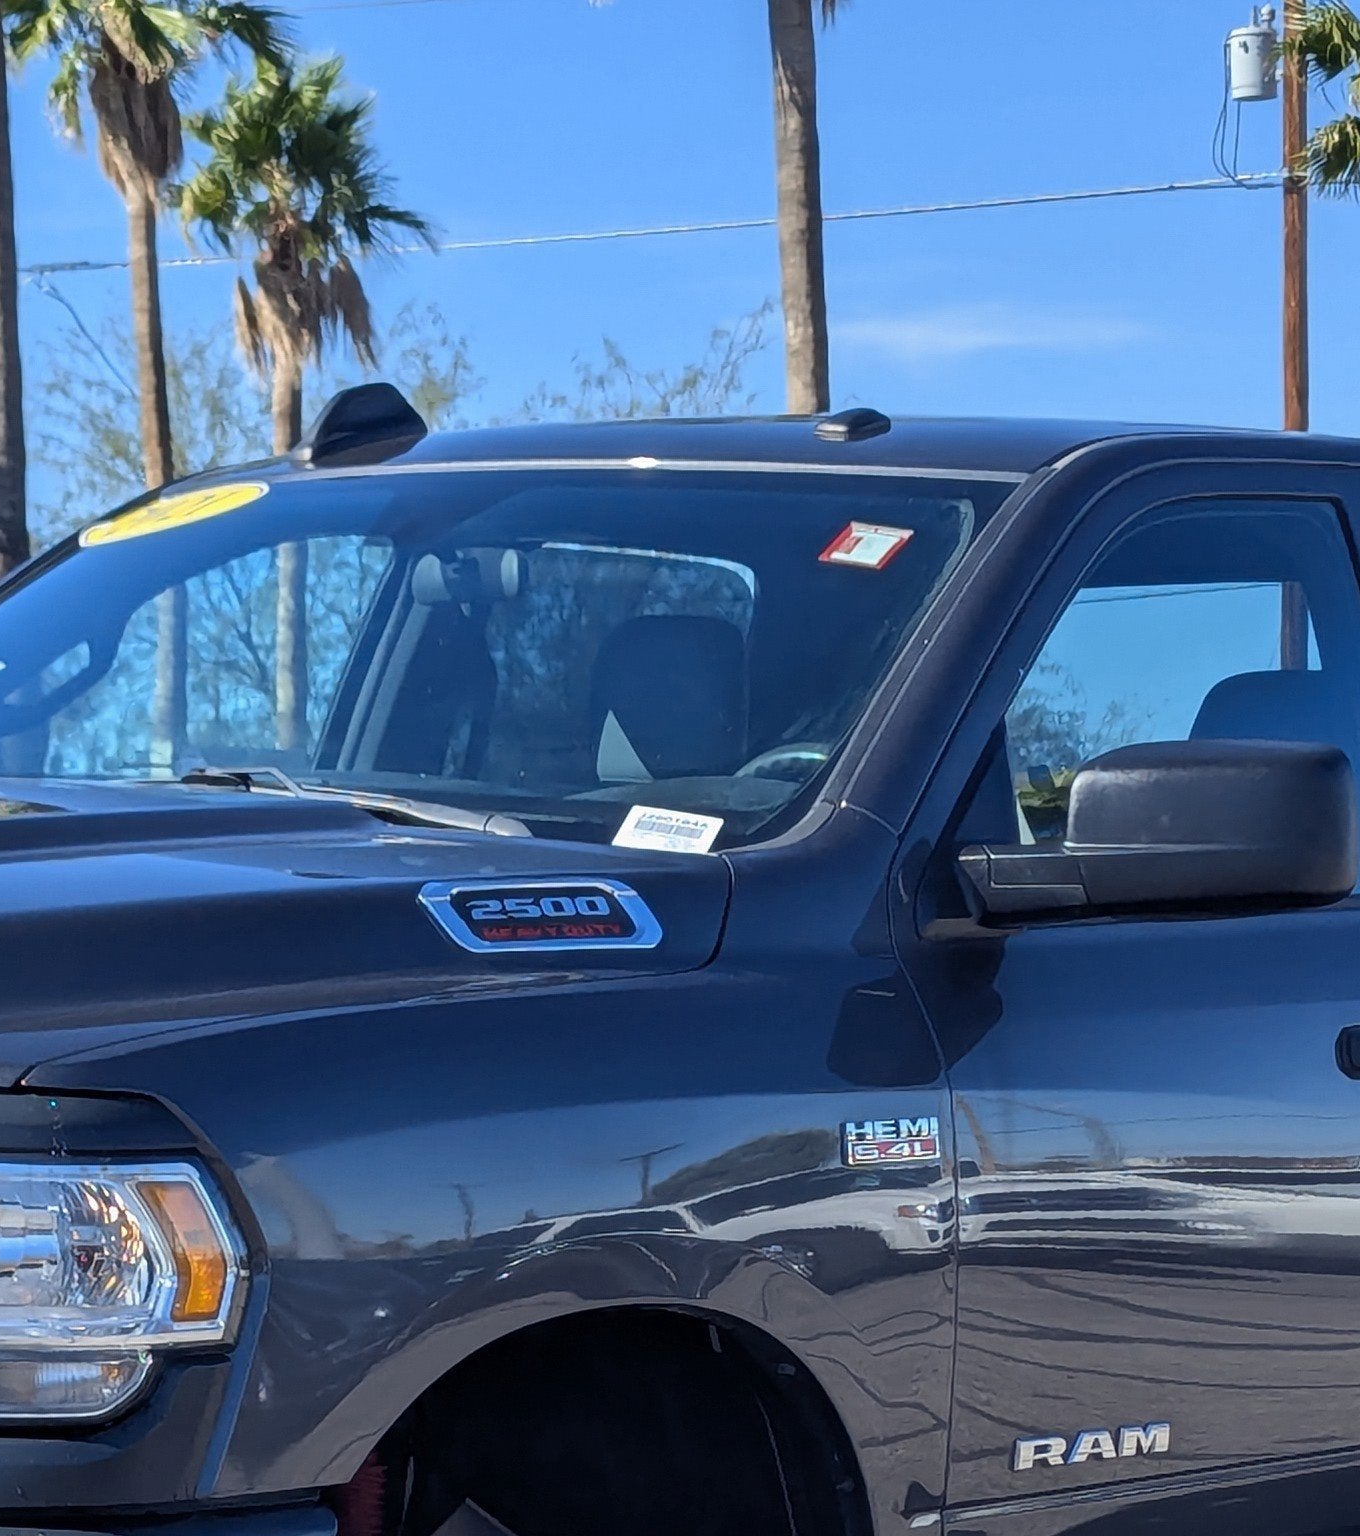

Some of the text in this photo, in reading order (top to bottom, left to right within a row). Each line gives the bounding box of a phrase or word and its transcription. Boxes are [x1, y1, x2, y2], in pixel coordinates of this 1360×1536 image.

[465, 895, 611, 921] 2500
[845, 1116, 939, 1140] HEMI
[1012, 1421, 1171, 1471] RAM
